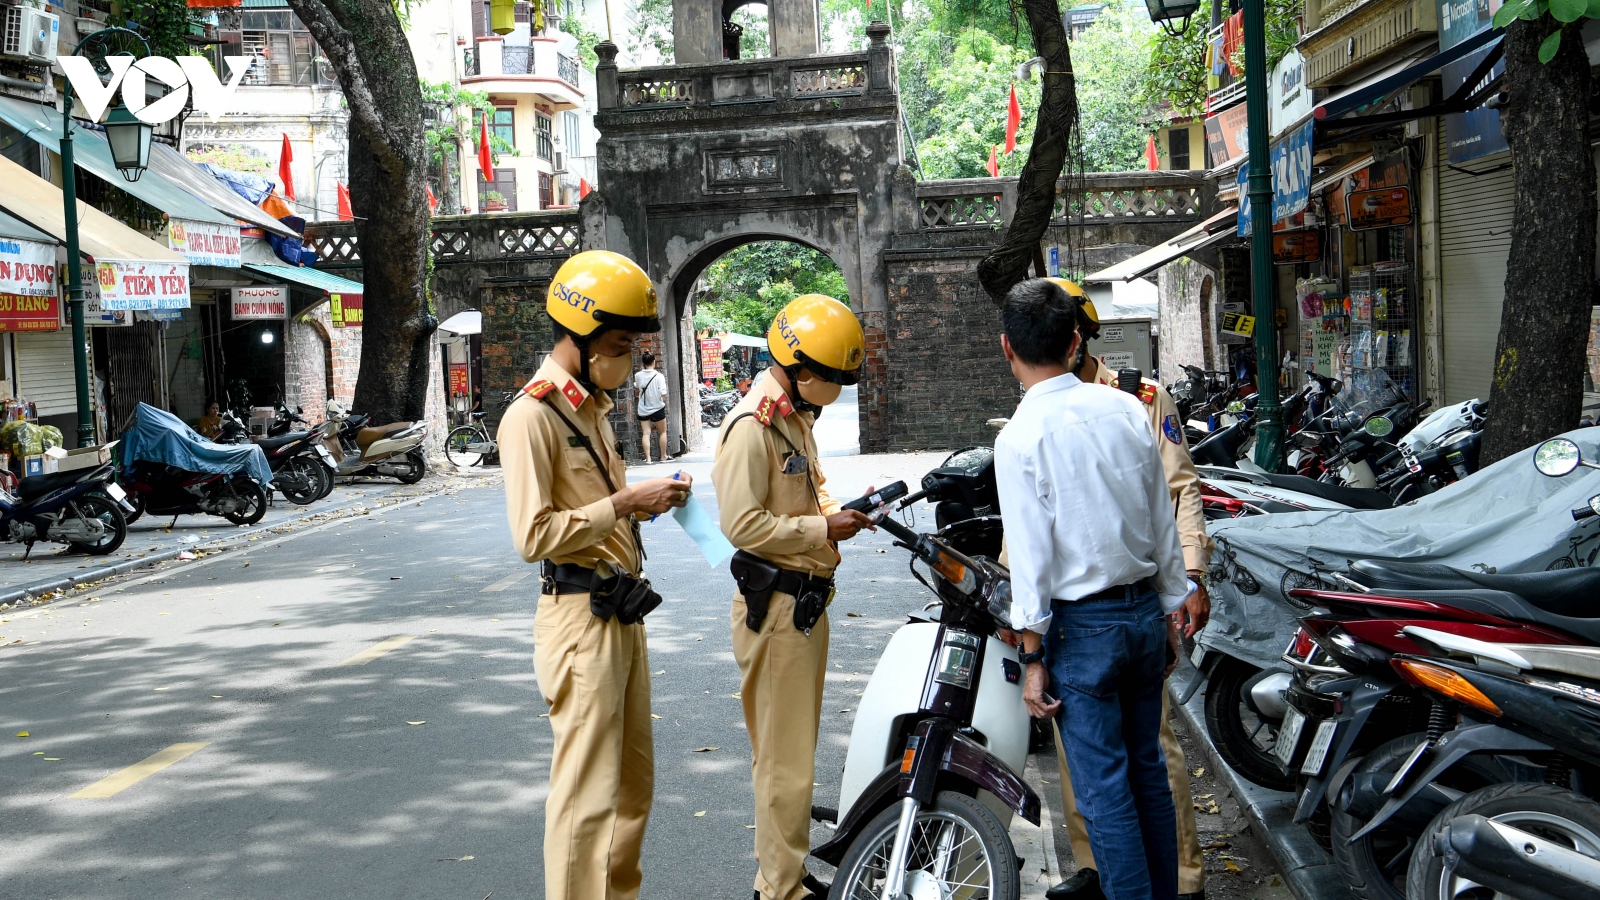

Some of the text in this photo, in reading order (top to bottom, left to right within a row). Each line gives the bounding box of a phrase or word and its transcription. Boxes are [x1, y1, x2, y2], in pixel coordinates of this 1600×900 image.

[1450, 2, 1474, 19] Microsoft
[14, 262, 55, 287] DỤNG
[98, 267, 116, 286] 15A
[122, 266, 187, 296] TIẾN YẾN
[234, 300, 250, 315] BÁNH
[268, 300, 285, 314] NÓNG
[553, 282, 595, 313] CSGT
[777, 311, 800, 349] CSGT
[1364, 683, 1379, 691] CTM
